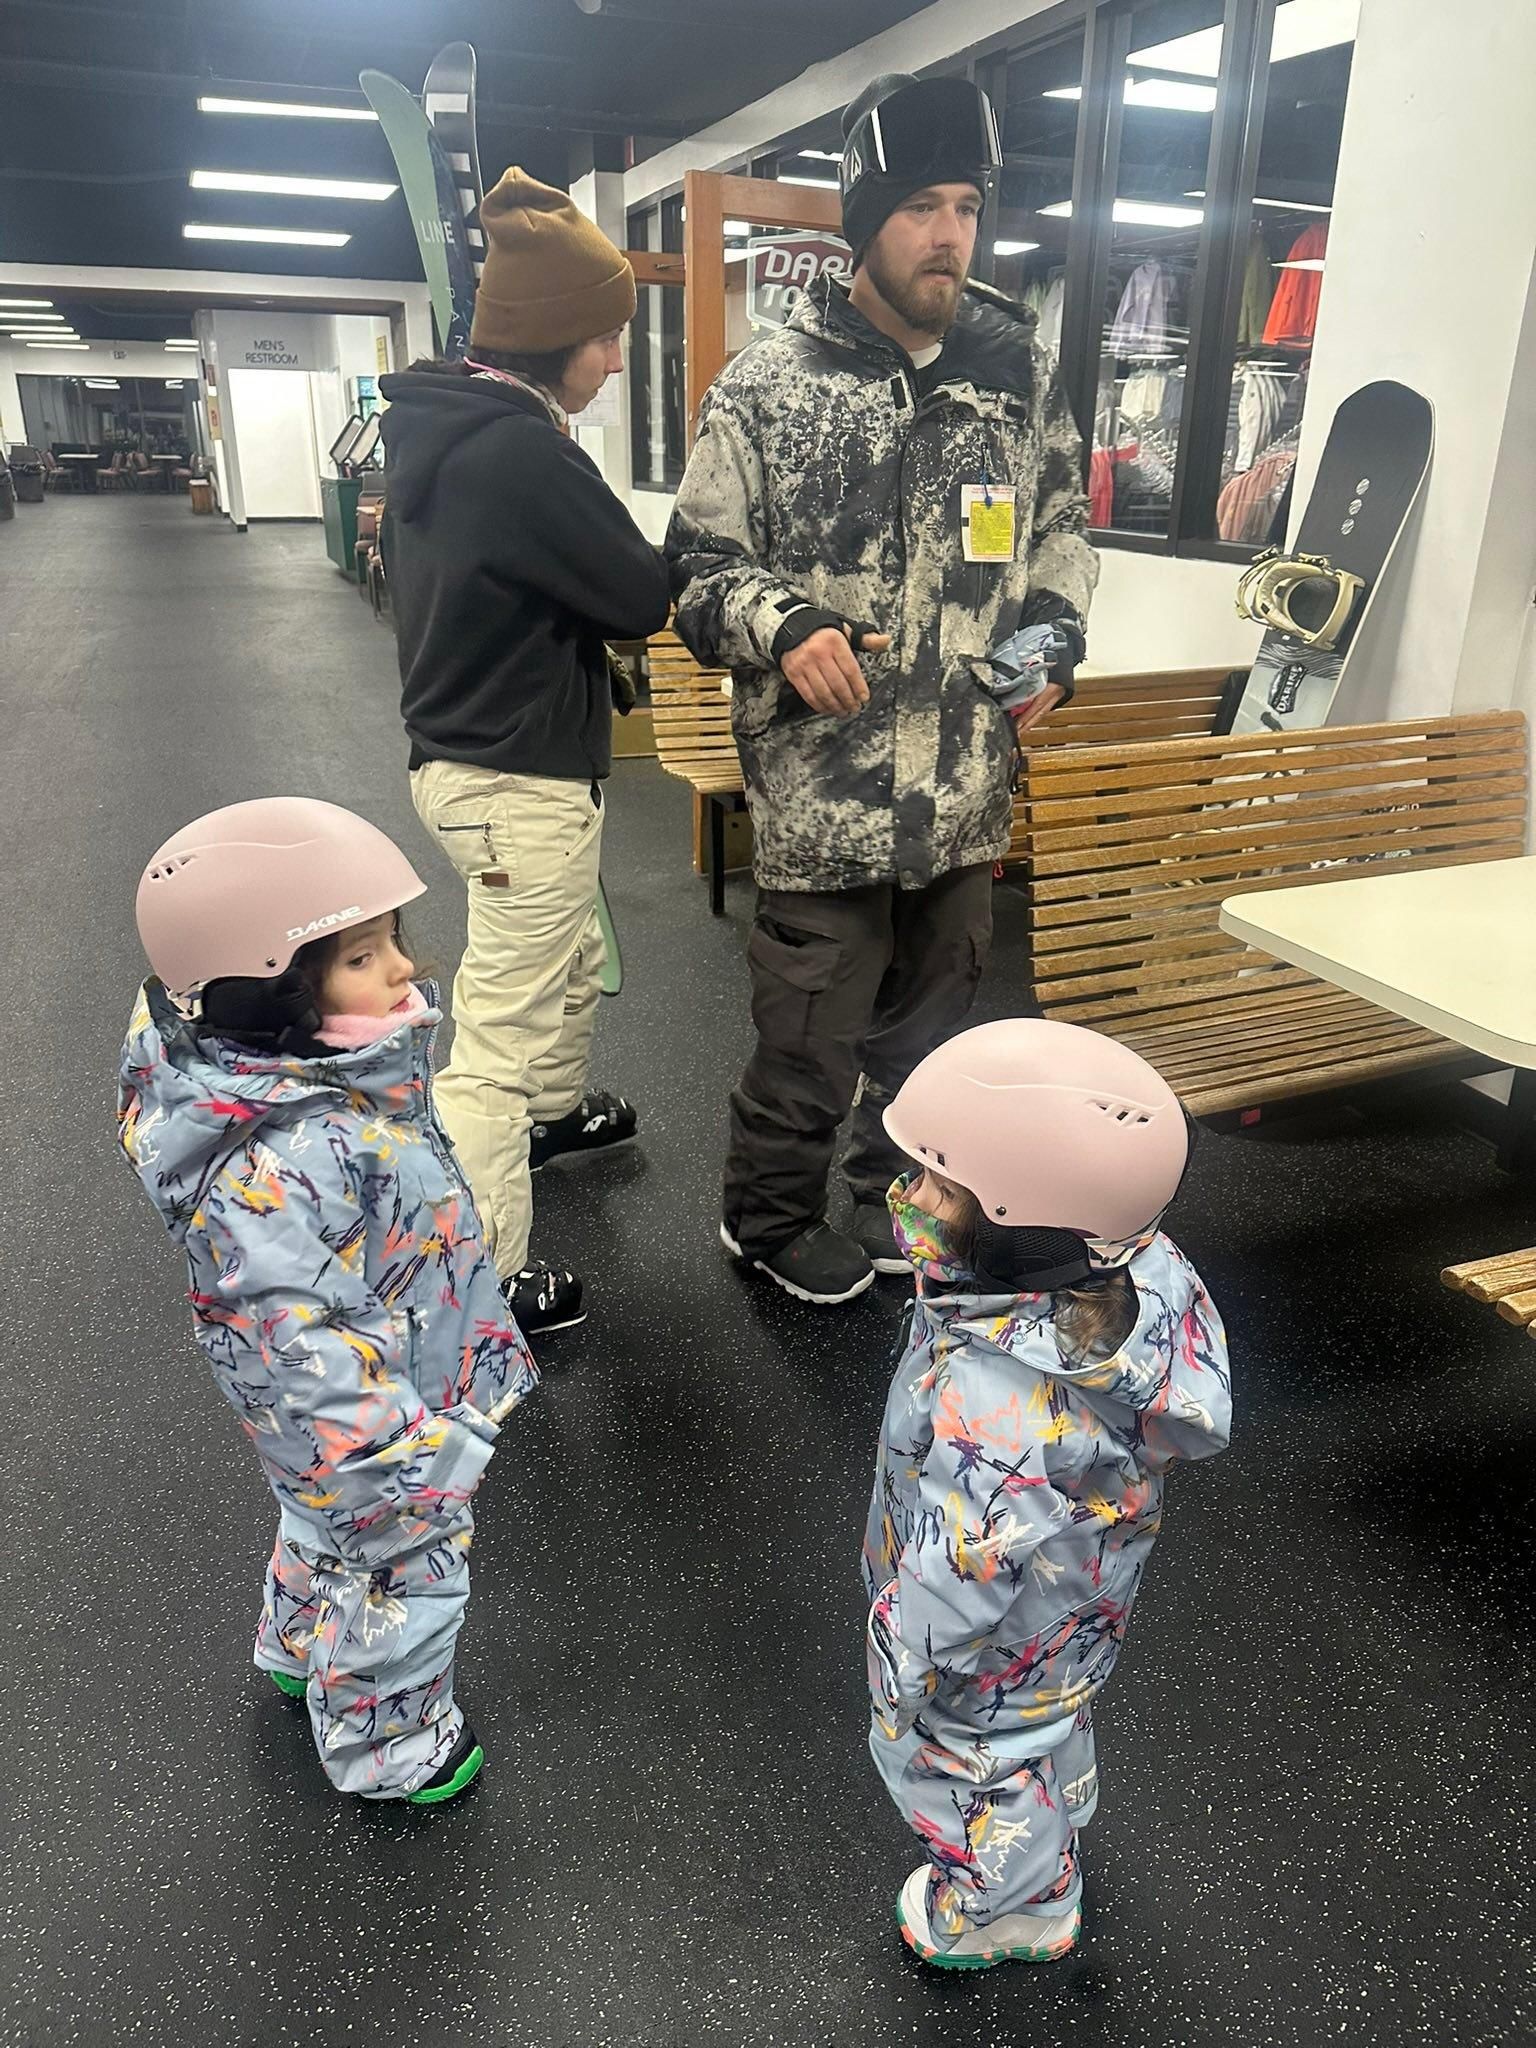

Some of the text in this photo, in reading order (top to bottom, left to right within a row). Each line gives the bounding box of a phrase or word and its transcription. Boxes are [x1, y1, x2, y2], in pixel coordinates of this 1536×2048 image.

[420, 220, 455, 244] LINE
[764, 248, 853, 285] DAR
[761, 283, 801, 311] TO
[446, 287, 465, 347] PAN
[245, 352, 299, 364] RESTROOM
[253, 340, 285, 351] MEN'S
[286, 905, 365, 942] DAKINE
